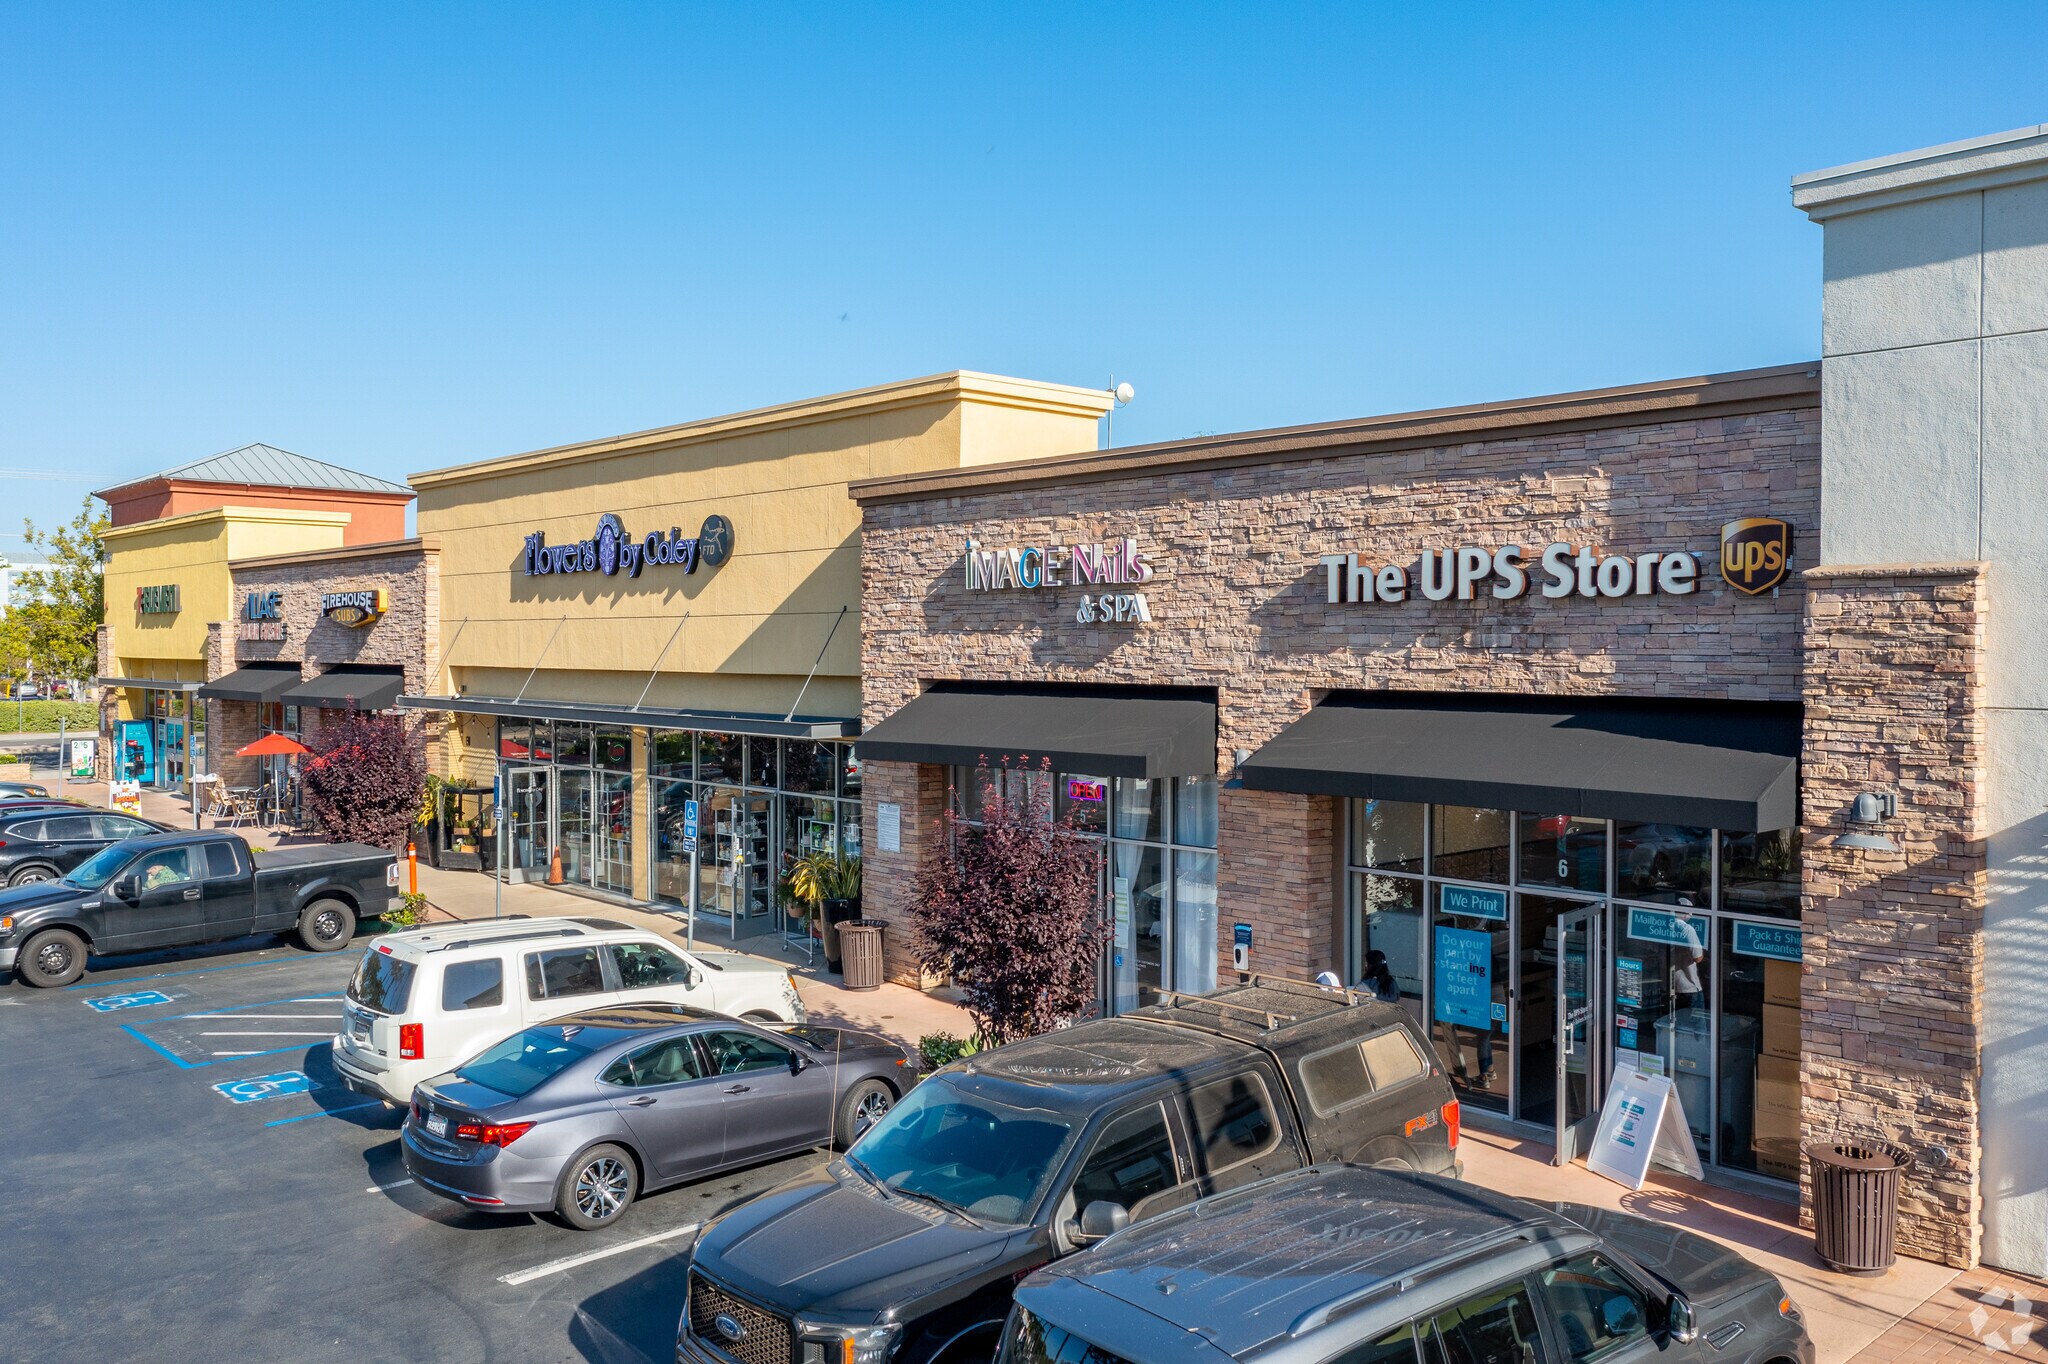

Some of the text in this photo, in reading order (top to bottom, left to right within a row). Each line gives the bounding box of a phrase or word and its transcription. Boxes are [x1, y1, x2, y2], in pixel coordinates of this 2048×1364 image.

[525, 528, 698, 578] Flowers by Coley
[702, 544, 715, 556] FTD
[1726, 541, 1782, 583] ups
[1320, 542, 1697, 603] The UPS Store
[321, 591, 373, 618] FIREHOUSE
[1076, 593, 1148, 624] & SPA
[336, 609, 356, 622] SUBS
[1071, 783, 1102, 799] OPEN
[1558, 859, 1568, 878] 6
[1450, 893, 1498, 912] We Print
[1634, 914, 1667, 928] Mailbox
[1649, 926, 1687, 940] Solutions
[1749, 928, 1771, 941] Pack
[1774, 932, 1782, 942] &
[1442, 934, 1484, 950] Do your
[1444, 949, 1482, 964] part by
[1440, 959, 1486, 978] standing
[1619, 960, 1640, 970] Hours
[1447, 971, 1478, 985] 6 feet
[1405, 1109, 1437, 1137] FX4
